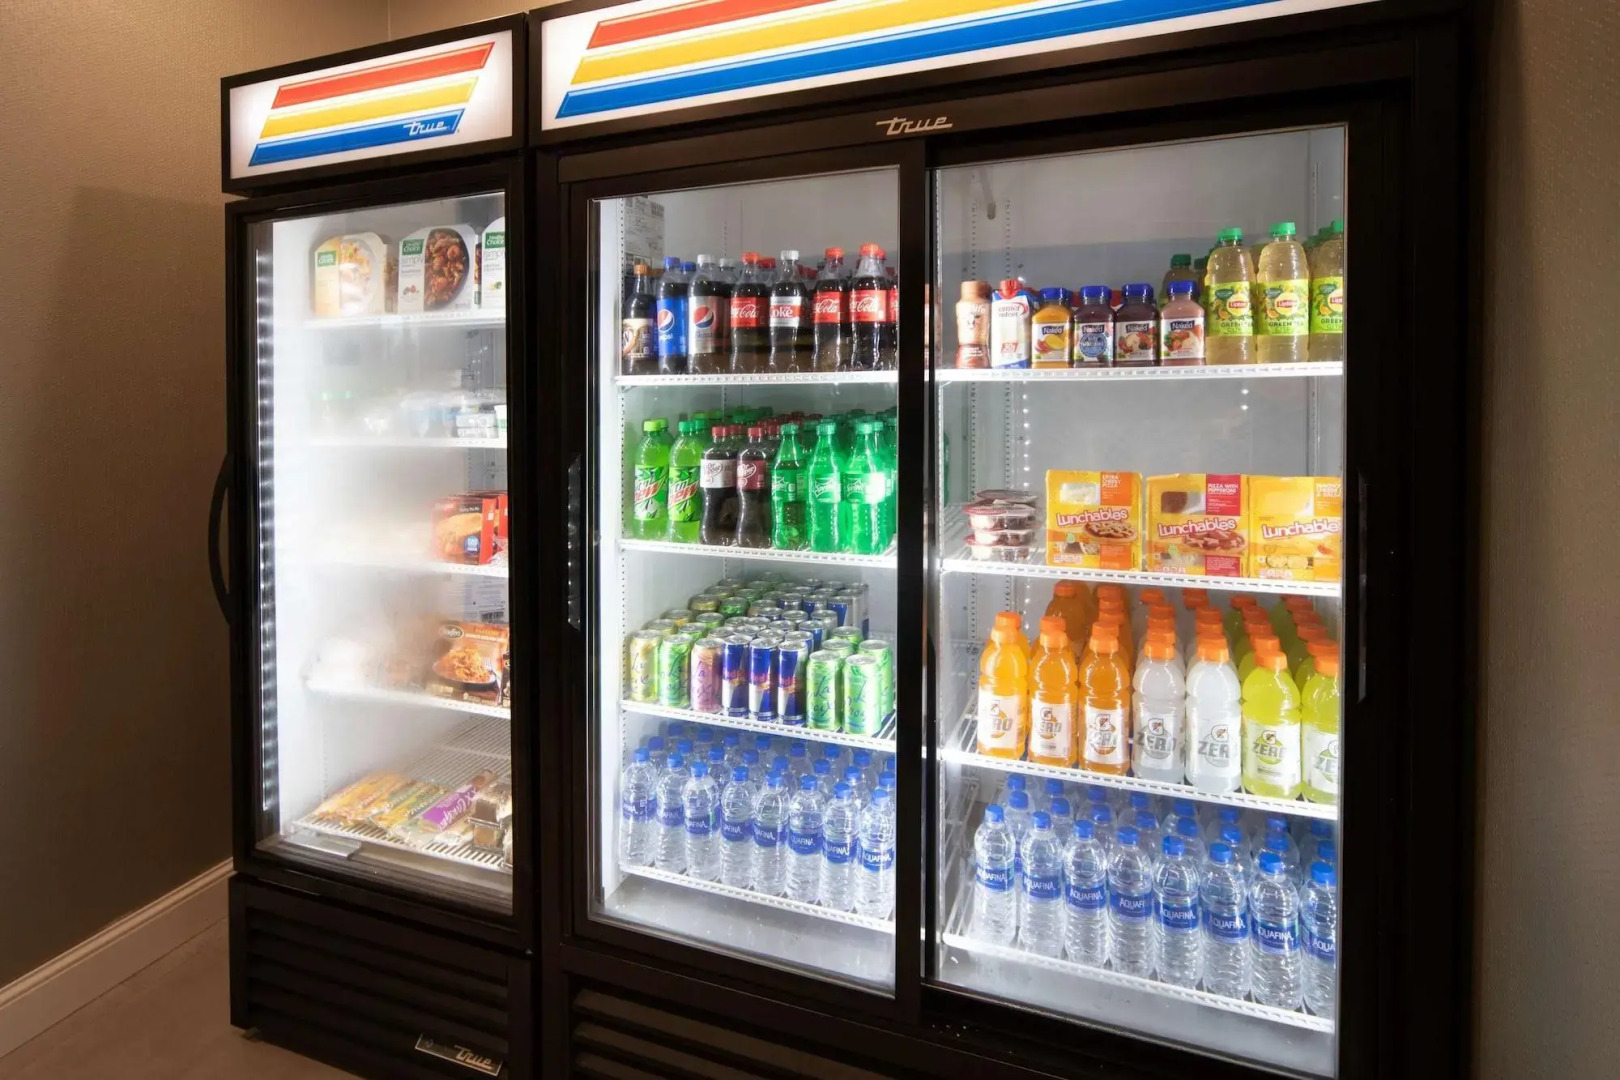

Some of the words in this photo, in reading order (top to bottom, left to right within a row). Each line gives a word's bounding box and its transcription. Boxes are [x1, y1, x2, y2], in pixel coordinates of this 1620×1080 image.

[1056, 508, 1128, 527] Lunchables
[1158, 518, 1236, 537] Lunchables
[1262, 519, 1341, 539] Lunchable
[1197, 740, 1230, 759] ZER
[1160, 907, 1197, 920] AQUAFINA
[1258, 928, 1295, 942] AQUAFINA
[1312, 938, 1336, 952] AQUA
